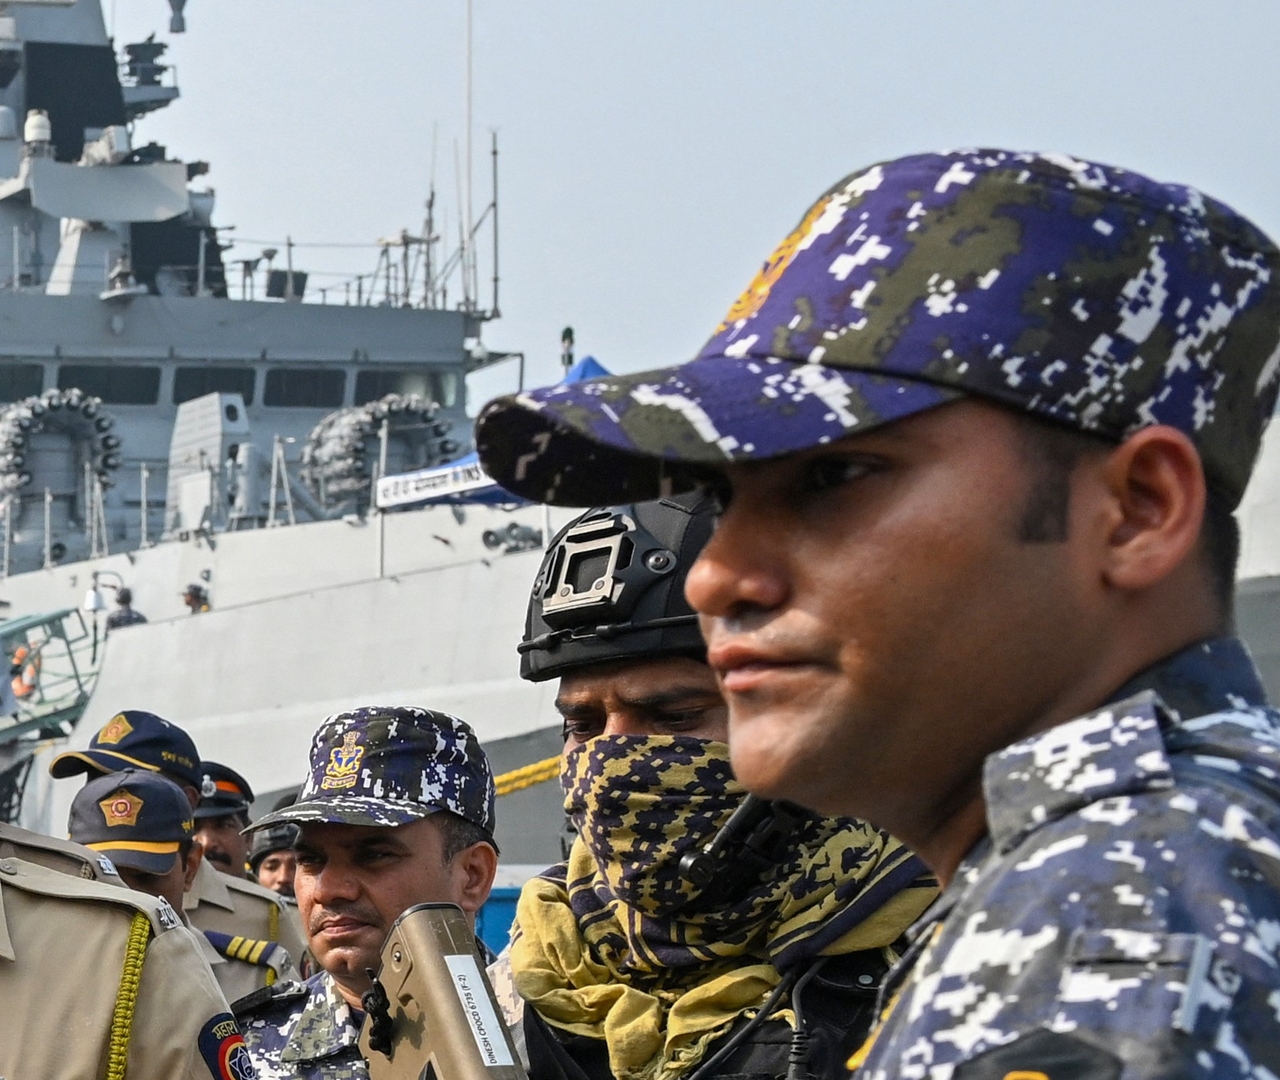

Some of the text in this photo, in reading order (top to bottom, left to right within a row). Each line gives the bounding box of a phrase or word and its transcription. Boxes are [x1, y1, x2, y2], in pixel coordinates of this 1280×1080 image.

[463, 992, 477, 1010] 6735
[211, 1020, 239, 1040] महारा
[480, 1037, 498, 1064] DINESH
